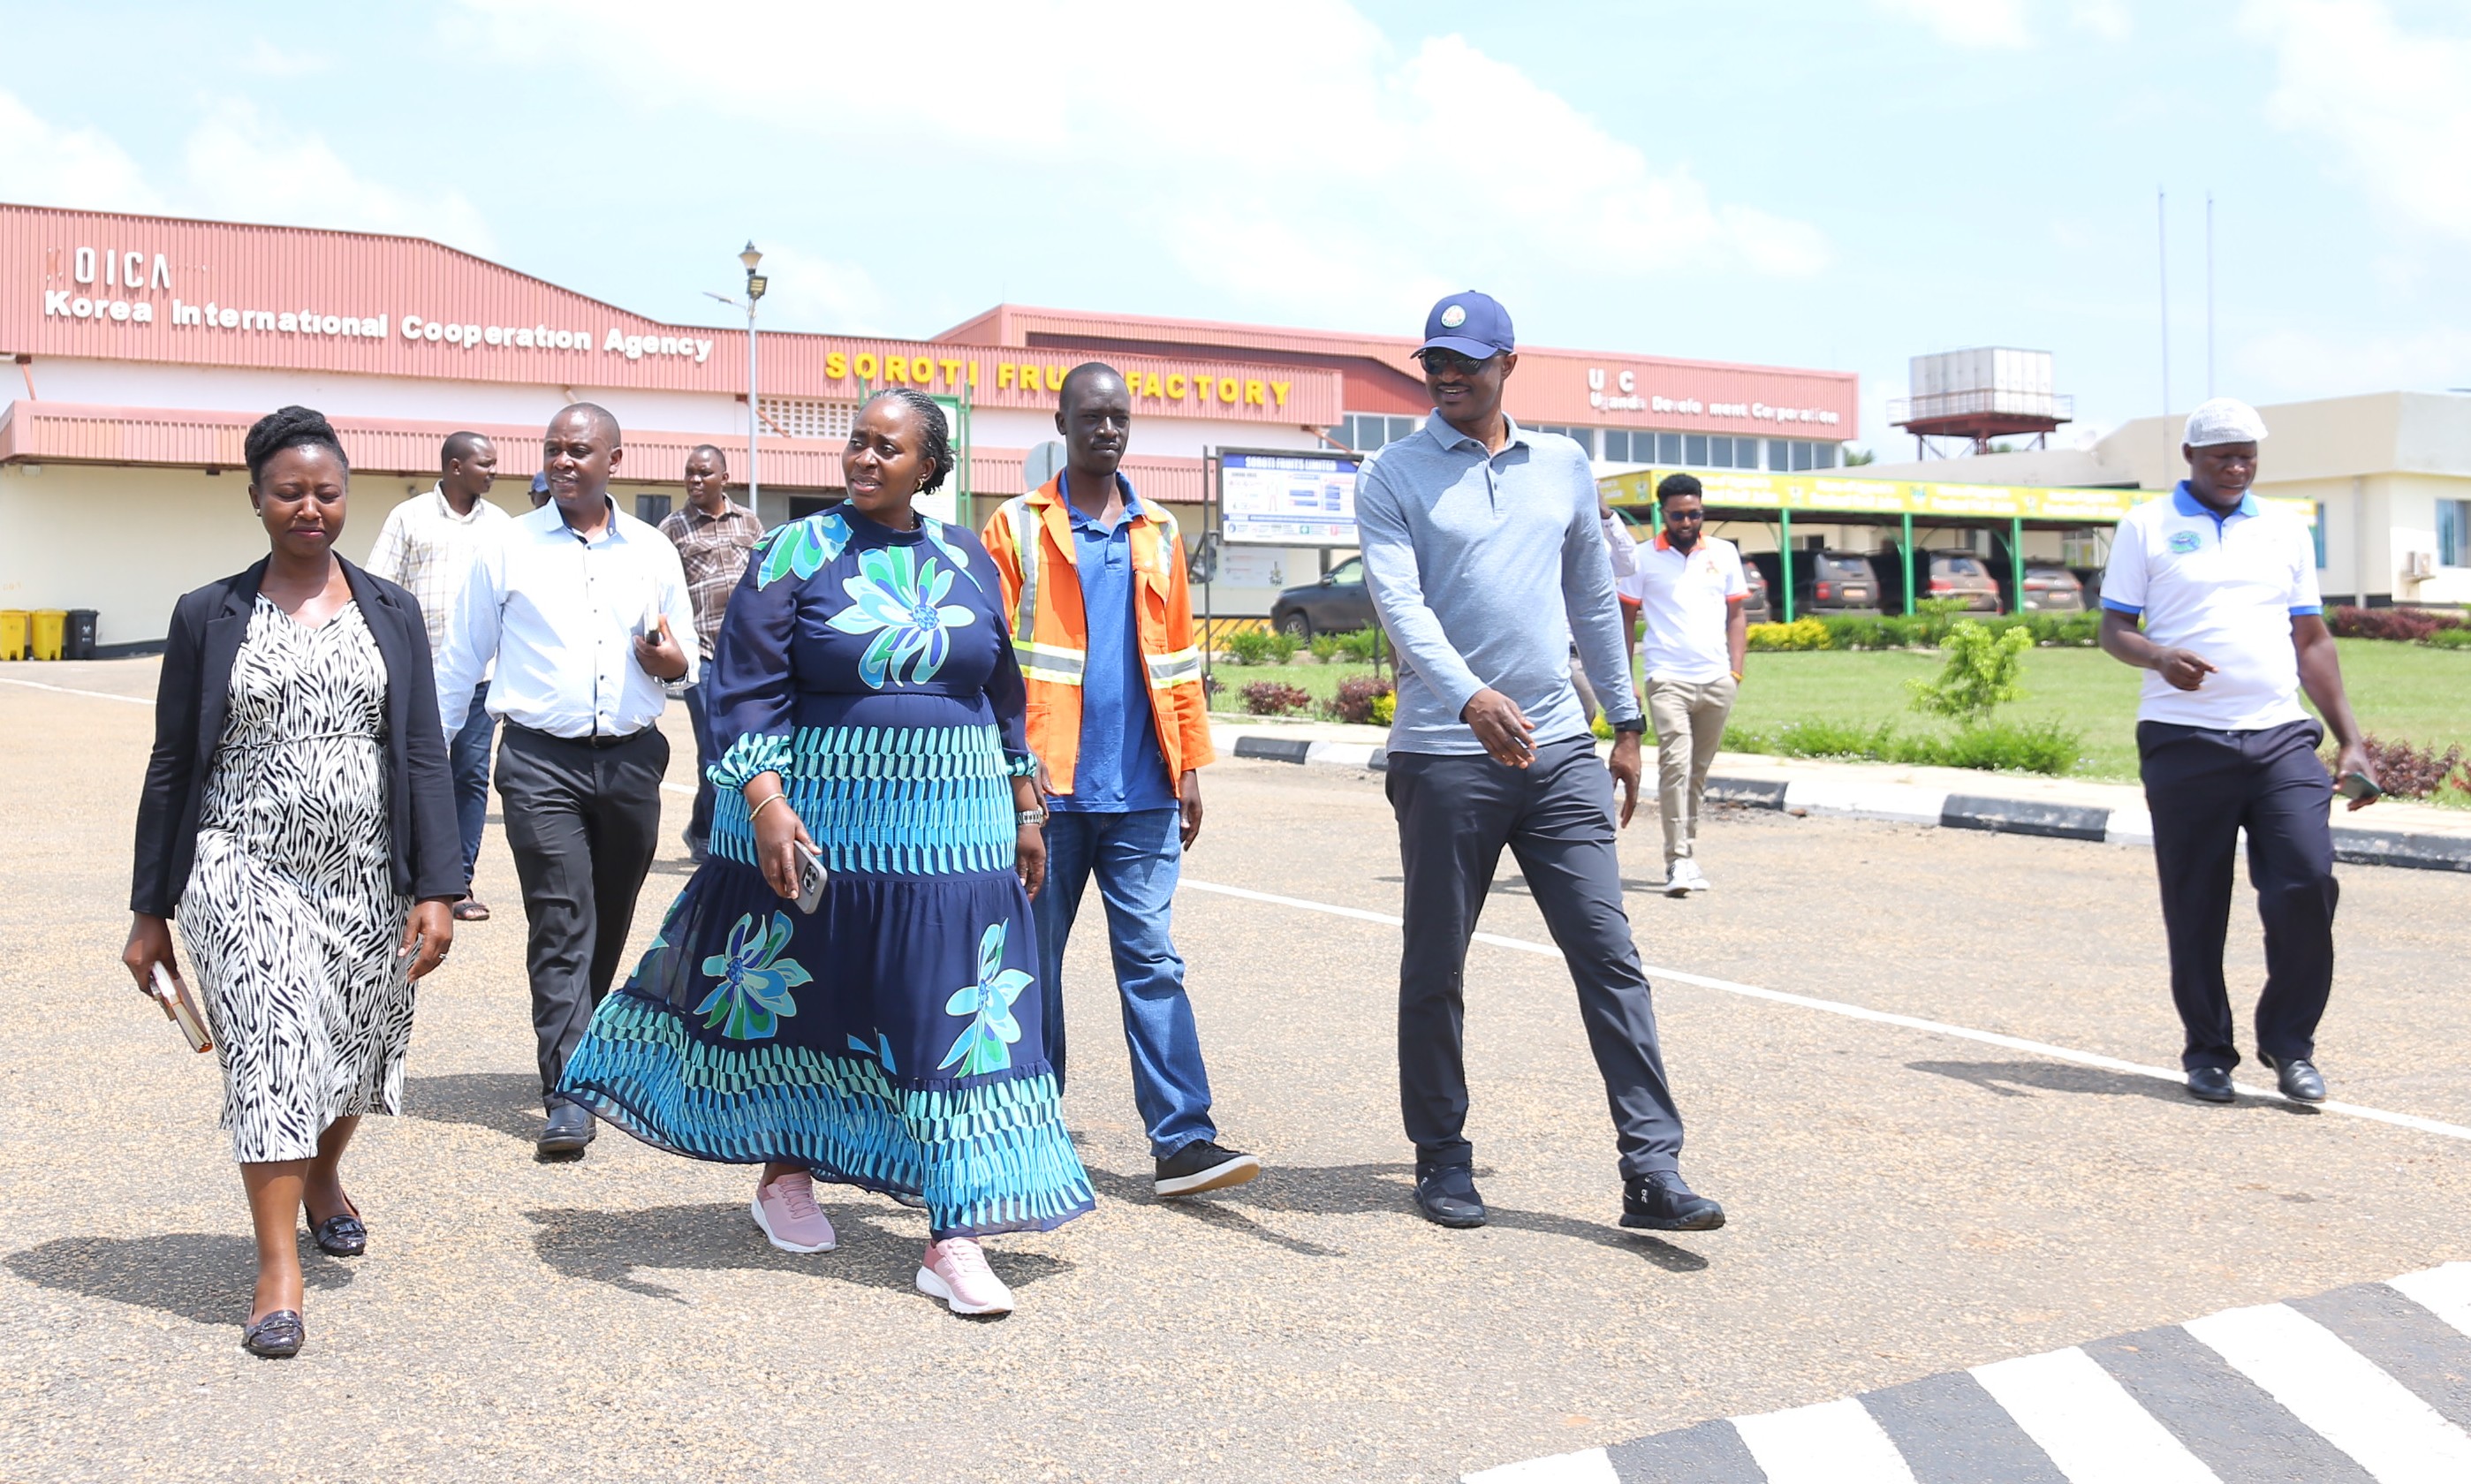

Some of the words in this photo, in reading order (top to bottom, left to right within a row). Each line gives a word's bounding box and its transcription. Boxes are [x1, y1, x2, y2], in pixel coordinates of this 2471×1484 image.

[44, 290, 153, 323] Korea
[171, 299, 389, 339] International
[400, 314, 592, 351] Cooperation
[603, 328, 713, 363] Agency
[824, 351, 978, 387] SOROTI
[997, 361, 1064, 390] FRU
[1126, 371, 1291, 405] FACTORY
[1589, 391, 1646, 413] Uganda
[1751, 402, 1839, 425] Corporation
[1245, 457, 1275, 468] SOROTI
[1276, 458, 1304, 470] FRUITS
[1305, 460, 1338, 471] LIMITED
